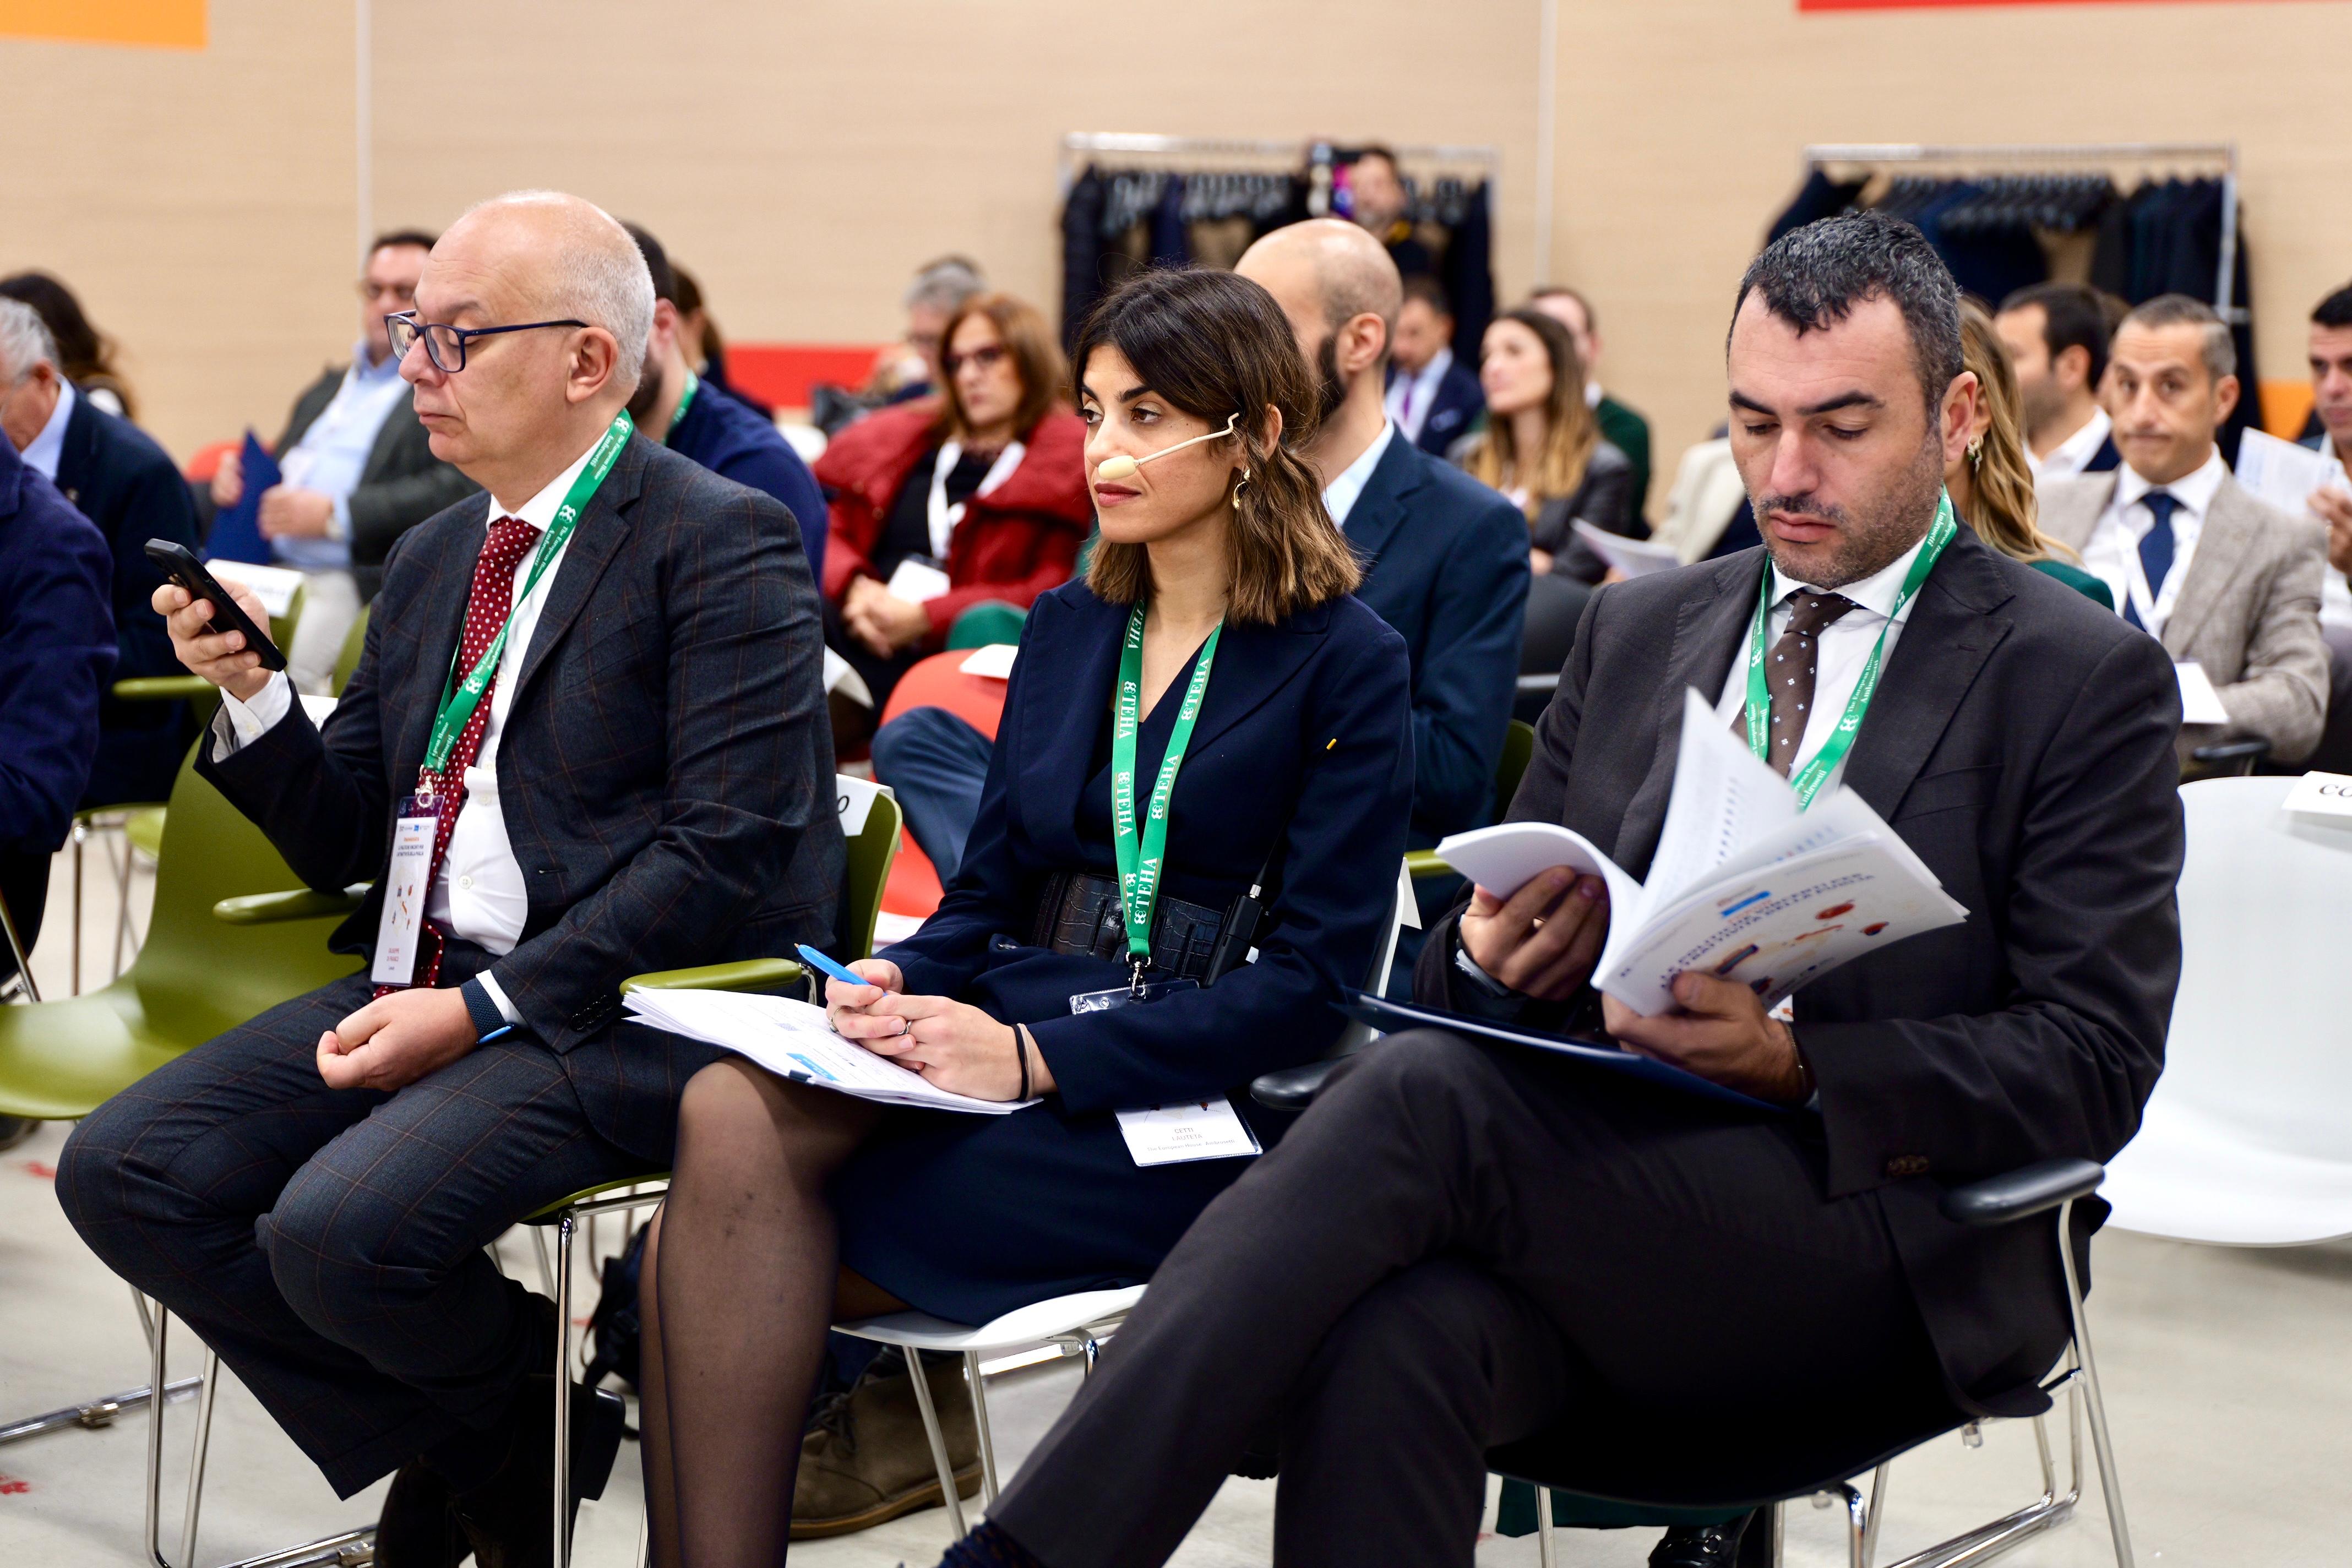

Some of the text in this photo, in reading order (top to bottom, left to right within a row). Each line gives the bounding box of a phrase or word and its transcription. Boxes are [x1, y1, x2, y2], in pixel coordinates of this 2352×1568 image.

[1927, 509, 1946, 547] Ambrosetti
[1185, 657, 1210, 707] TEHA
[1118, 695, 1136, 739] TEHA
[1153, 754, 1179, 804] TEHA
[1117, 784, 1134, 837] TEHA
[1135, 857, 1158, 909] TEHA
